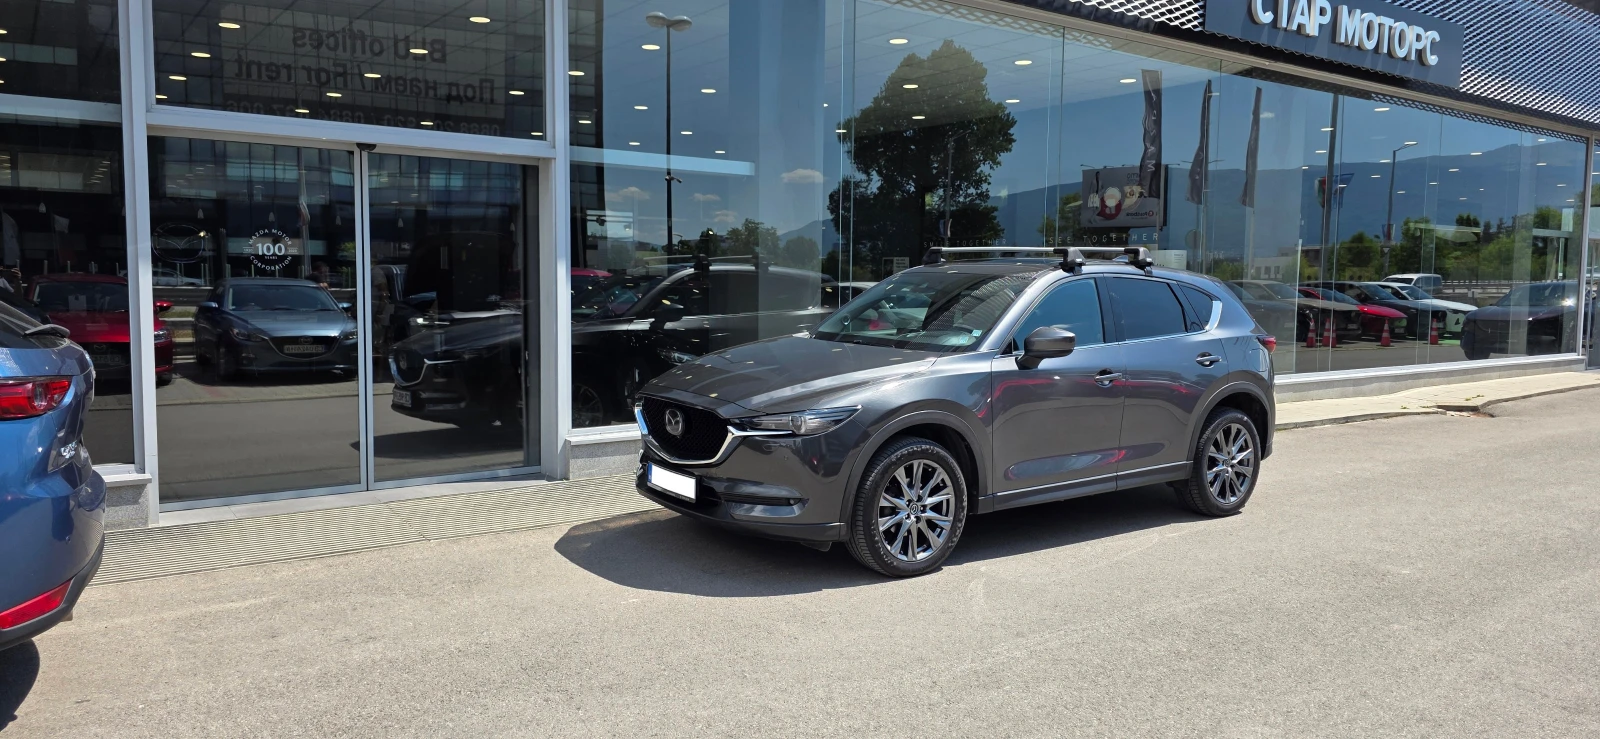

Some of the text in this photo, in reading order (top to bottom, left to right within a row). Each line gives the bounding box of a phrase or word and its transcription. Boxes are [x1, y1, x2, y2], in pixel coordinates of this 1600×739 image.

[1251, 0, 1440, 66] СТАР МОТОРС
[248, 229, 292, 246] MAZDA MOTOR
[956, 238, 1007, 247] TOGETHER
[1048, 233, 1159, 244] SEE TOGETHER
[256, 243, 285, 256] 100
[250, 255, 292, 270] CORPORATION
